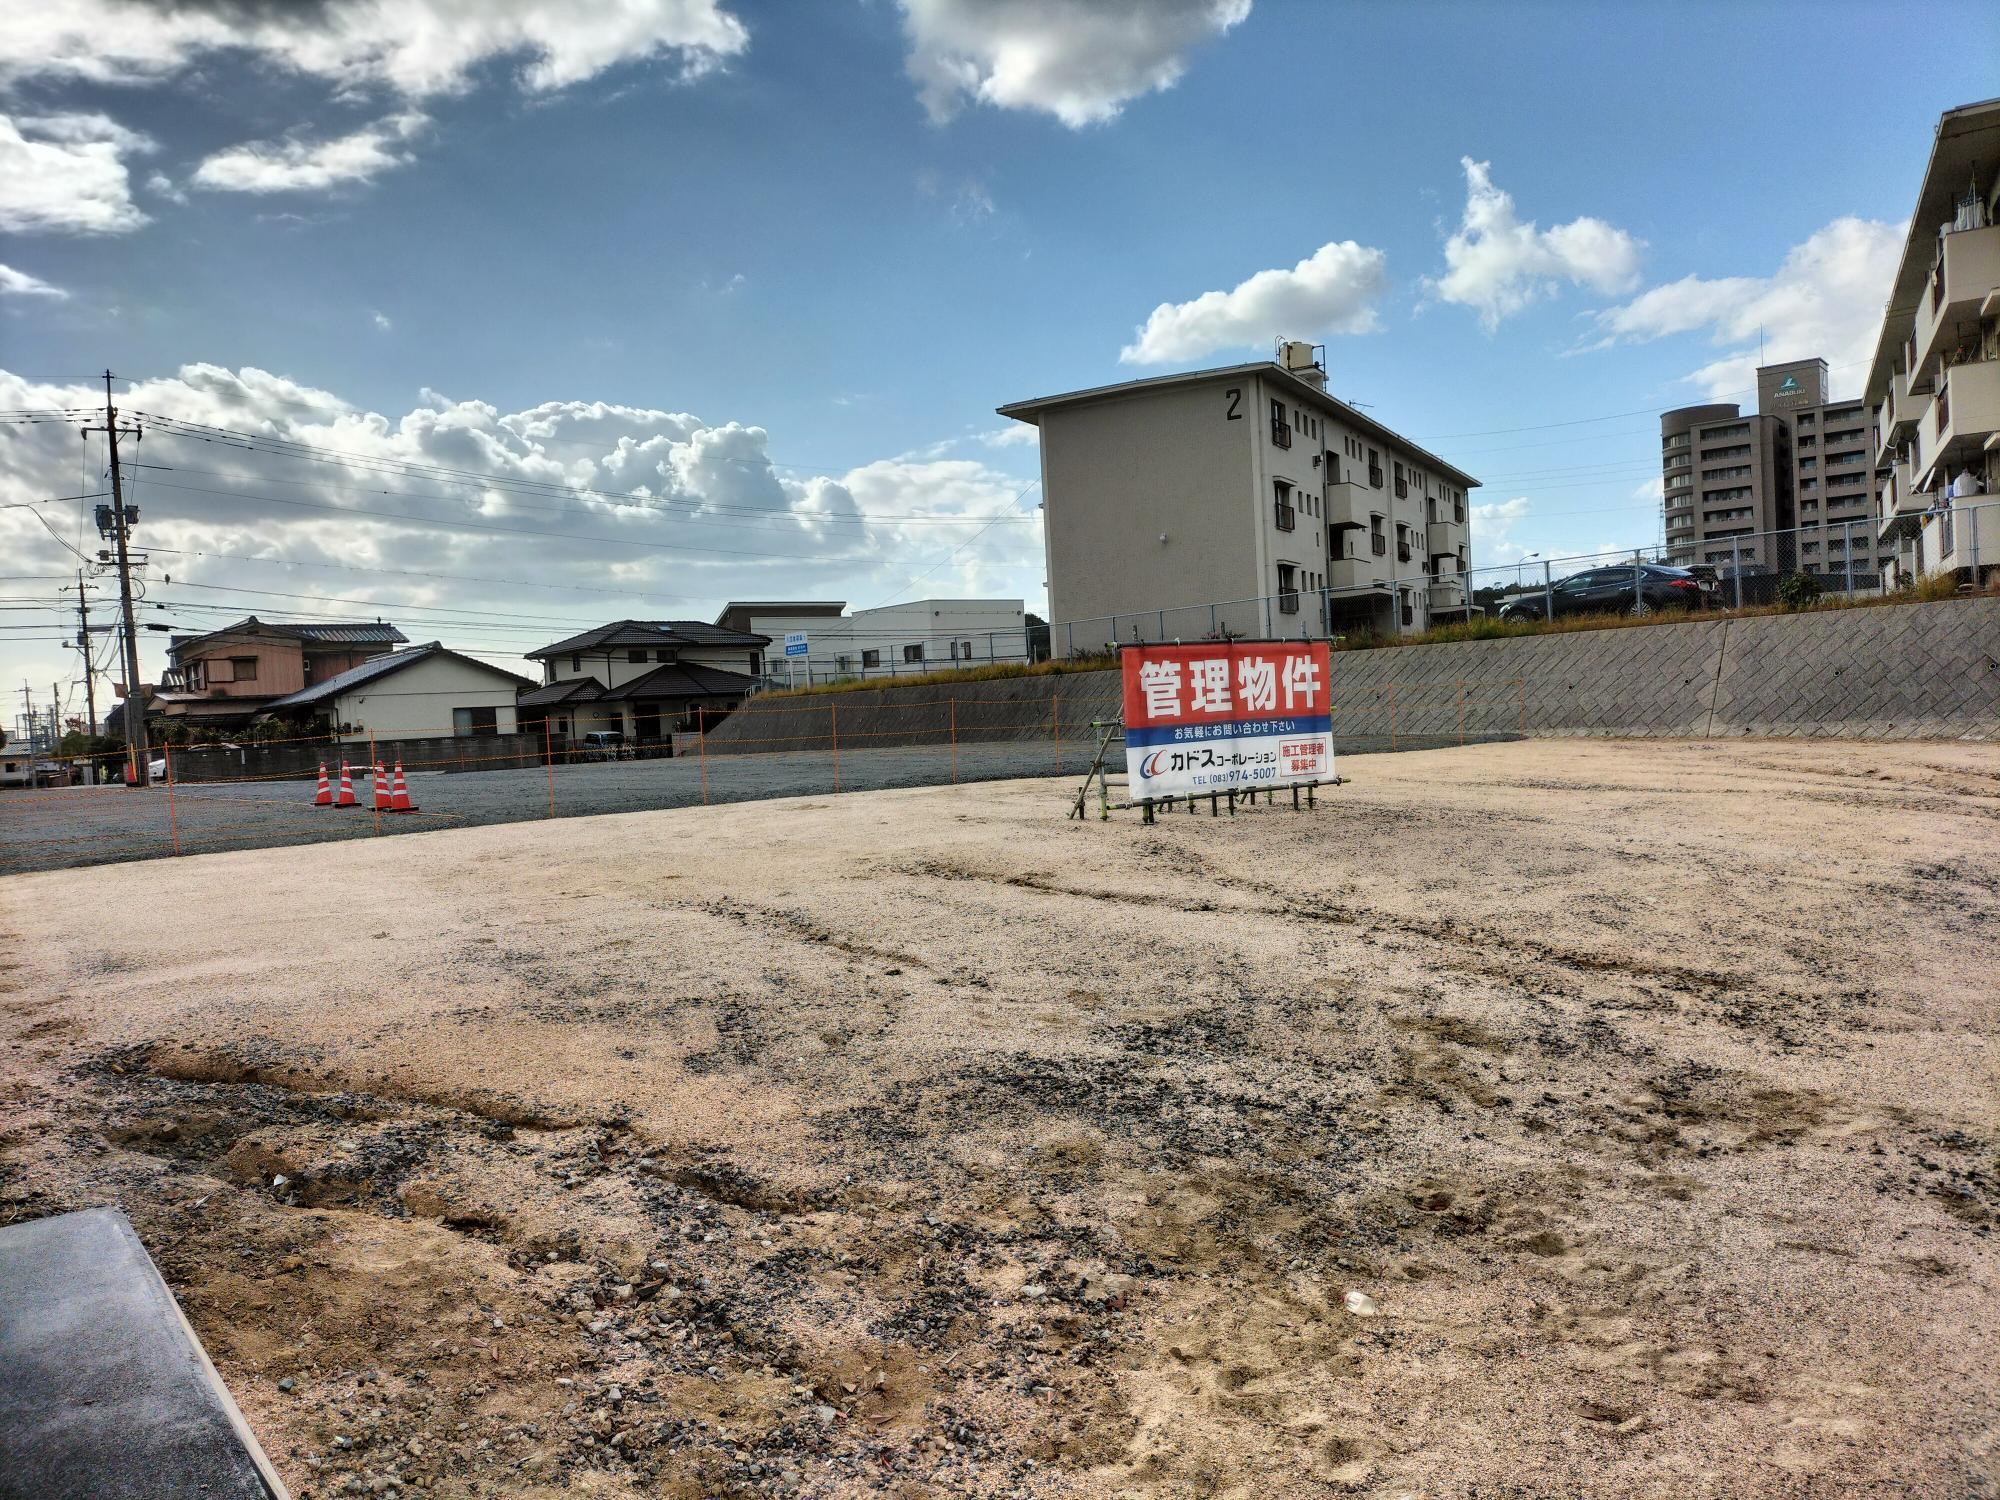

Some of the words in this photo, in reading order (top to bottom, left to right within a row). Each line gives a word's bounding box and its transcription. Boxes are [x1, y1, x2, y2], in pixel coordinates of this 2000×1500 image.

[1226, 389, 1242, 420] 2
[1139, 655, 1321, 719] 管理物件
[1174, 720, 1295, 740] お気軽にお問い合わせ下さい
[1171, 748, 1277, 772] カドスコーポレーション
[1282, 742, 1325, 758] 施工管理者
[1291, 758, 1317, 772] 募集中
[1192, 776, 1207, 785] TEL
[1209, 767, 1277, 784] (083)974-5007
